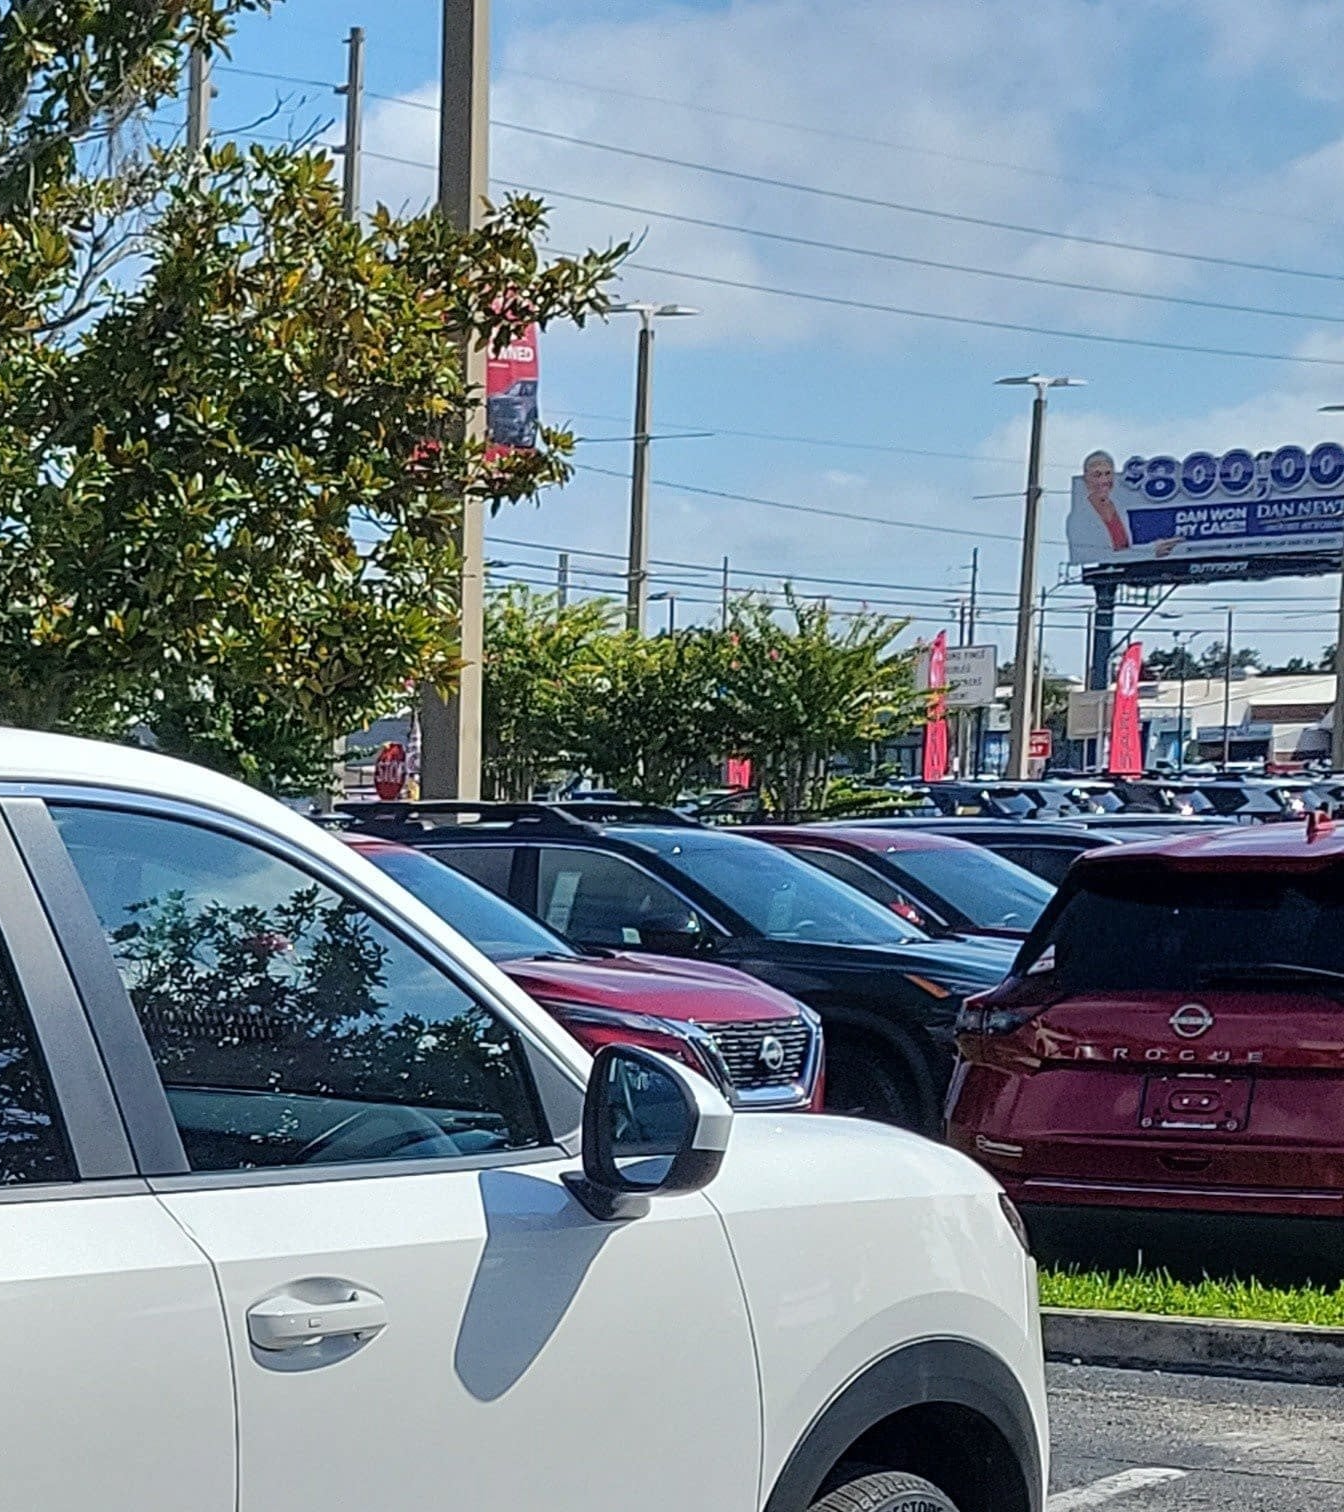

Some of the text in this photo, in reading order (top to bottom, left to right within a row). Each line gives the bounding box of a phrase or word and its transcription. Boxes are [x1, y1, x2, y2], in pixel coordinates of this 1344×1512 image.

[1175, 506, 1247, 524] DAN WON
[1113, 1048, 1263, 1063] ROGUE
